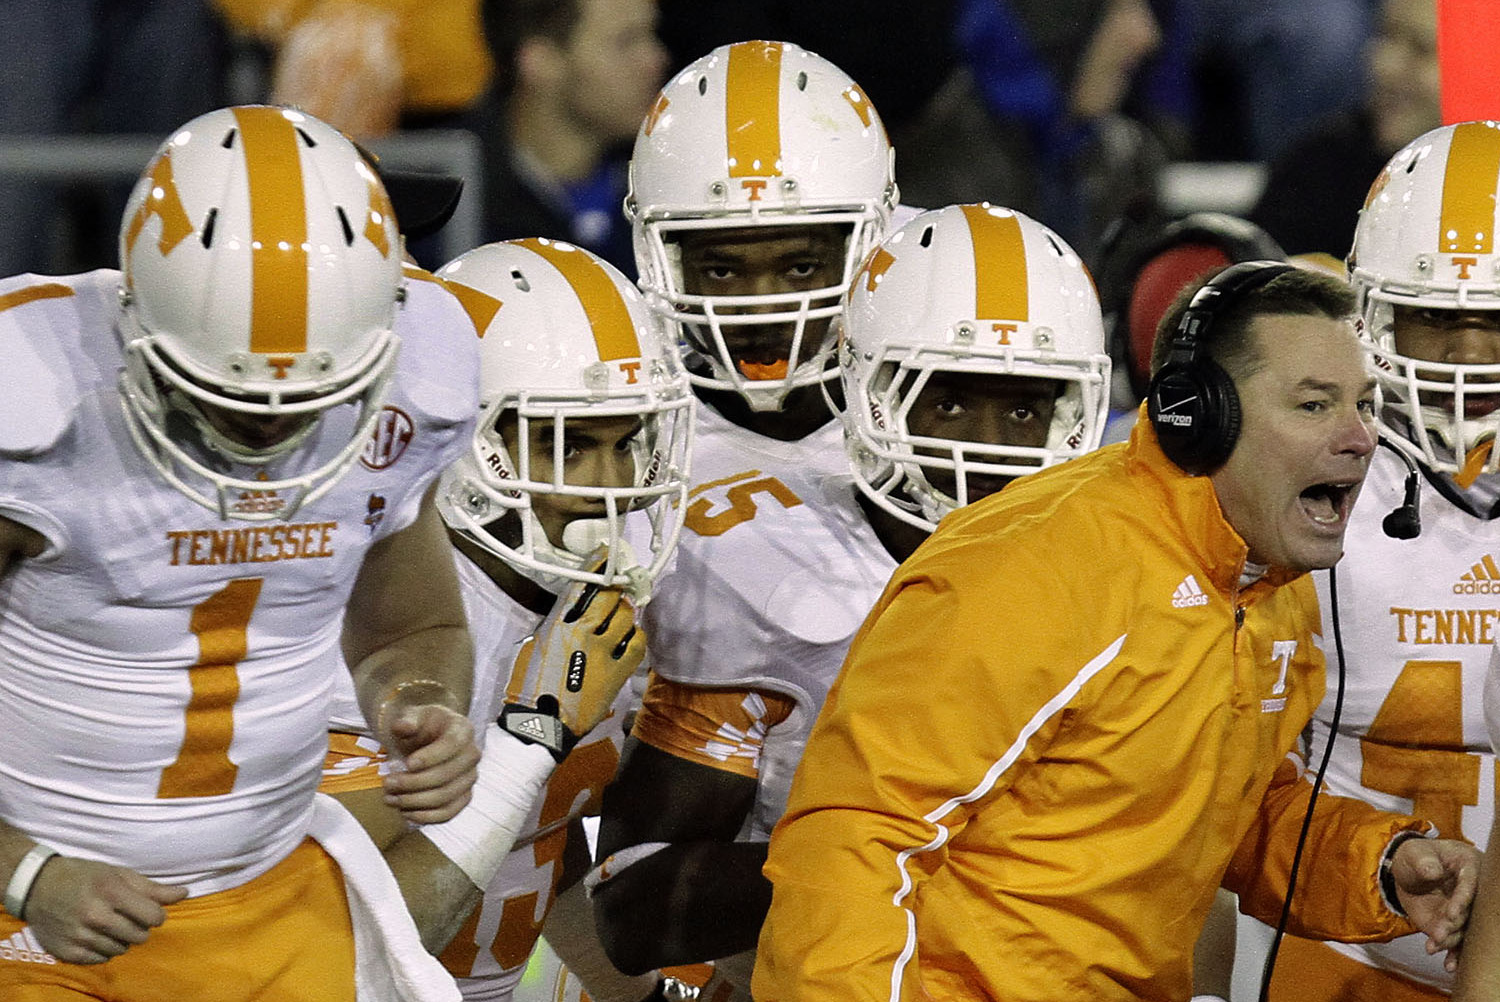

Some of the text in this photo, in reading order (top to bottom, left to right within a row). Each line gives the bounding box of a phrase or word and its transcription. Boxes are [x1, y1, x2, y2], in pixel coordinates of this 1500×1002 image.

[741, 180, 766, 201] T
[1451, 257, 1477, 280] T
[992, 324, 1018, 345] T
[267, 356, 295, 379] T
[619, 362, 641, 384] T
[1157, 412, 1192, 426] verizon
[167, 522, 338, 566] TENNESSEE
[1171, 594, 1210, 609] adidas
[1273, 640, 1297, 694] T
[157, 577, 264, 799] 1
